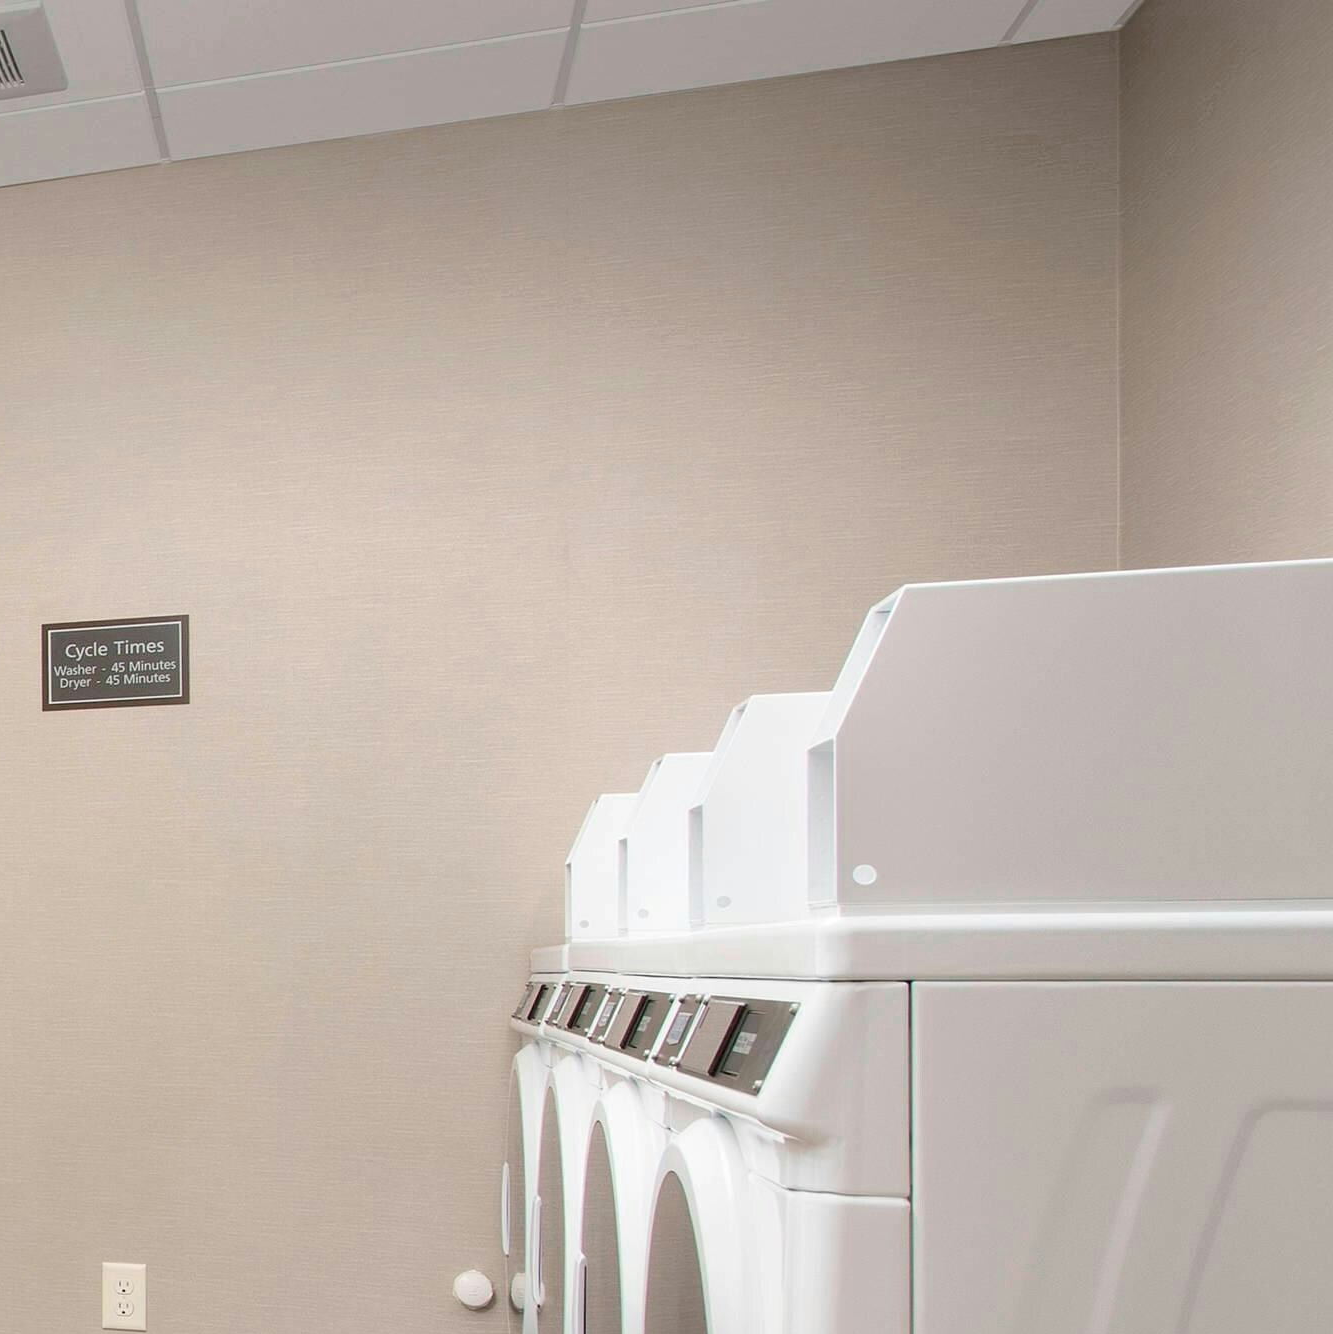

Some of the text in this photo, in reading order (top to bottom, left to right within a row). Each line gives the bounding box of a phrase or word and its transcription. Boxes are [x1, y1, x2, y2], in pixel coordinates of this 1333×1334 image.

[65, 640, 165, 661] Cycle Times
[53, 664, 97, 676] Washer
[111, 661, 125, 673] 45
[129, 660, 177, 672] Minutes
[59, 676, 92, 690] Dryer
[105, 674, 120, 686] 45
[123, 673, 171, 685] Minutes
